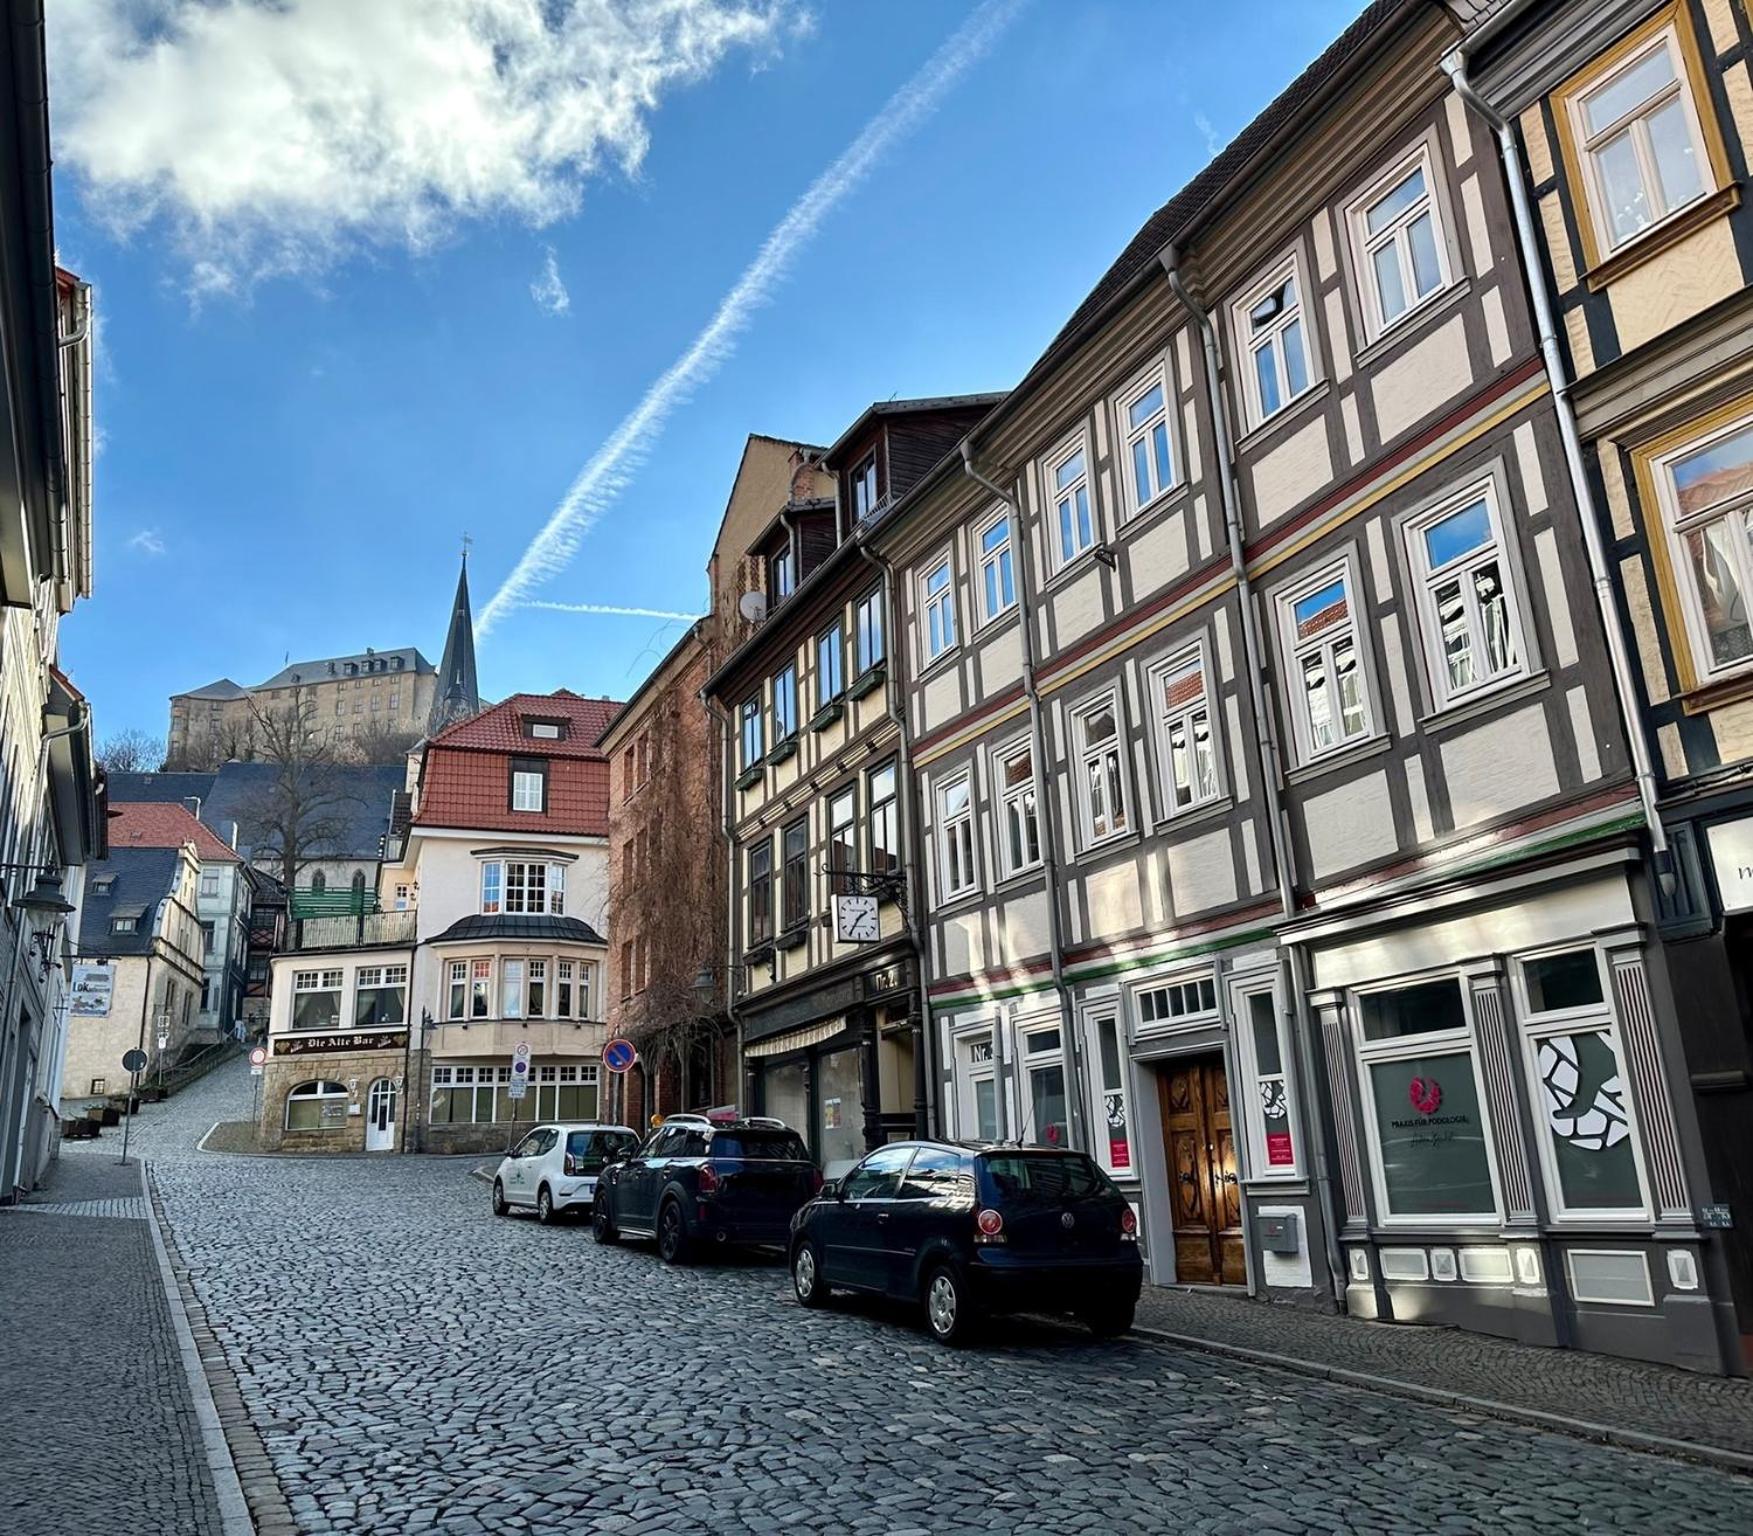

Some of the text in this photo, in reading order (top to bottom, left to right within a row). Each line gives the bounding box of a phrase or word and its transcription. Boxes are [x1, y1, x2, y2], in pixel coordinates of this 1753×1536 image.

[307, 1038, 325, 1047] Die
[328, 1037, 351, 1047] Alte
[353, 1035, 374, 1046] Bar
